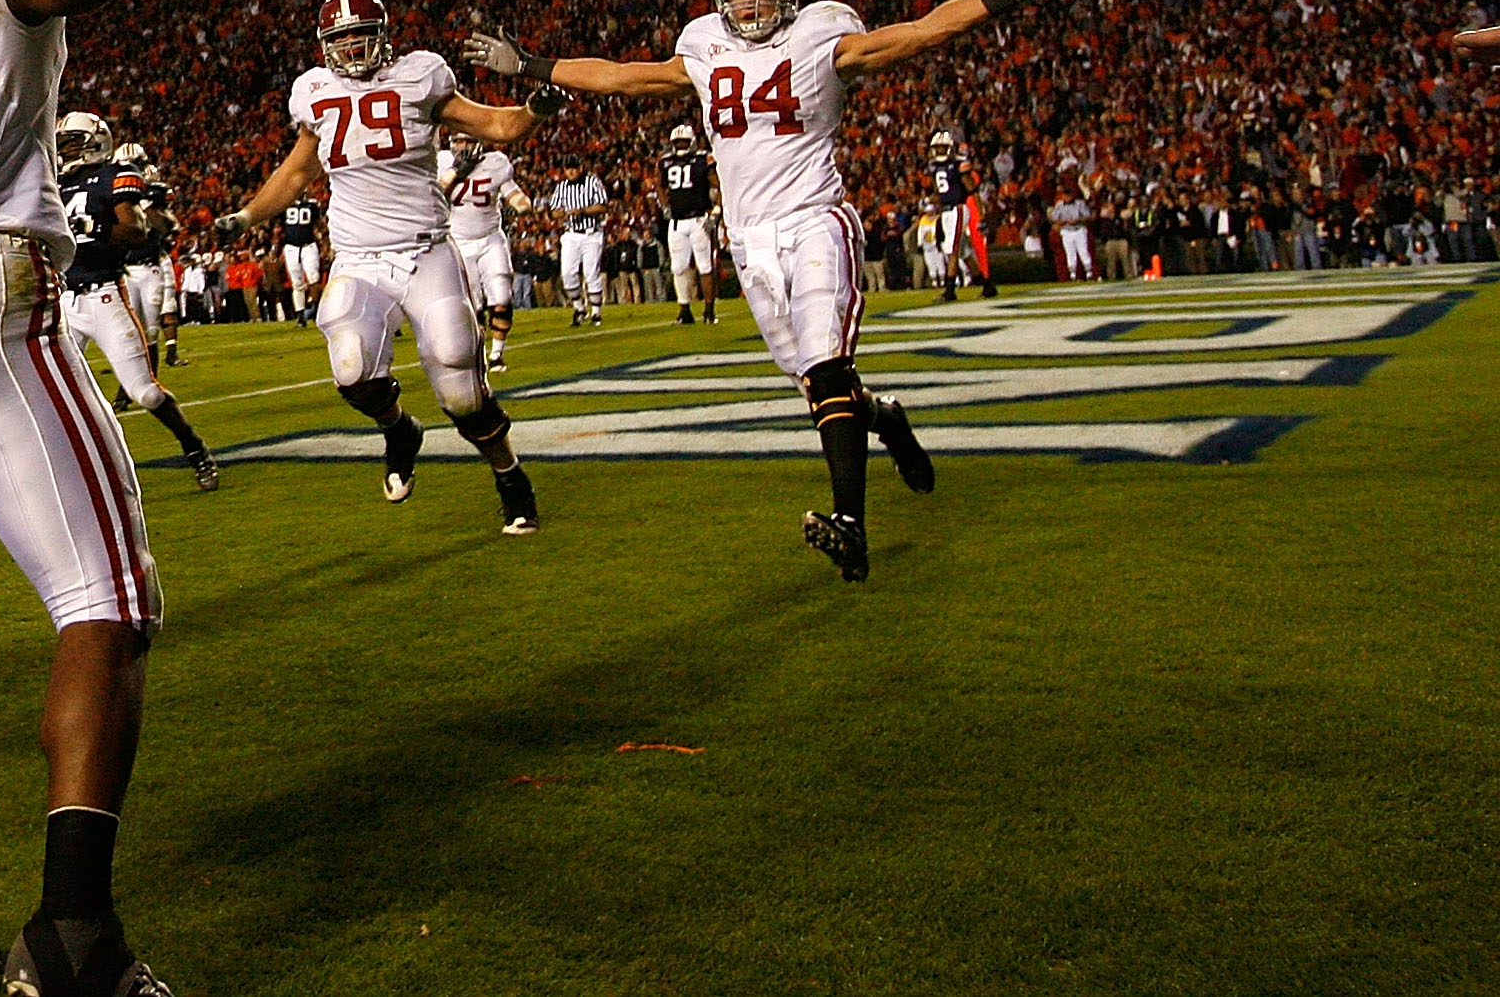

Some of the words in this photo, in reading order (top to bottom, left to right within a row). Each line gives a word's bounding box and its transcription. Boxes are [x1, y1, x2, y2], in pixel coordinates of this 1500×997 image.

[708, 58, 804, 138] 84
[311, 90, 407, 170] 79
[667, 164, 693, 190] 91
[935, 170, 949, 193] 6
[452, 177, 493, 207] 75
[285, 207, 312, 225] 90
